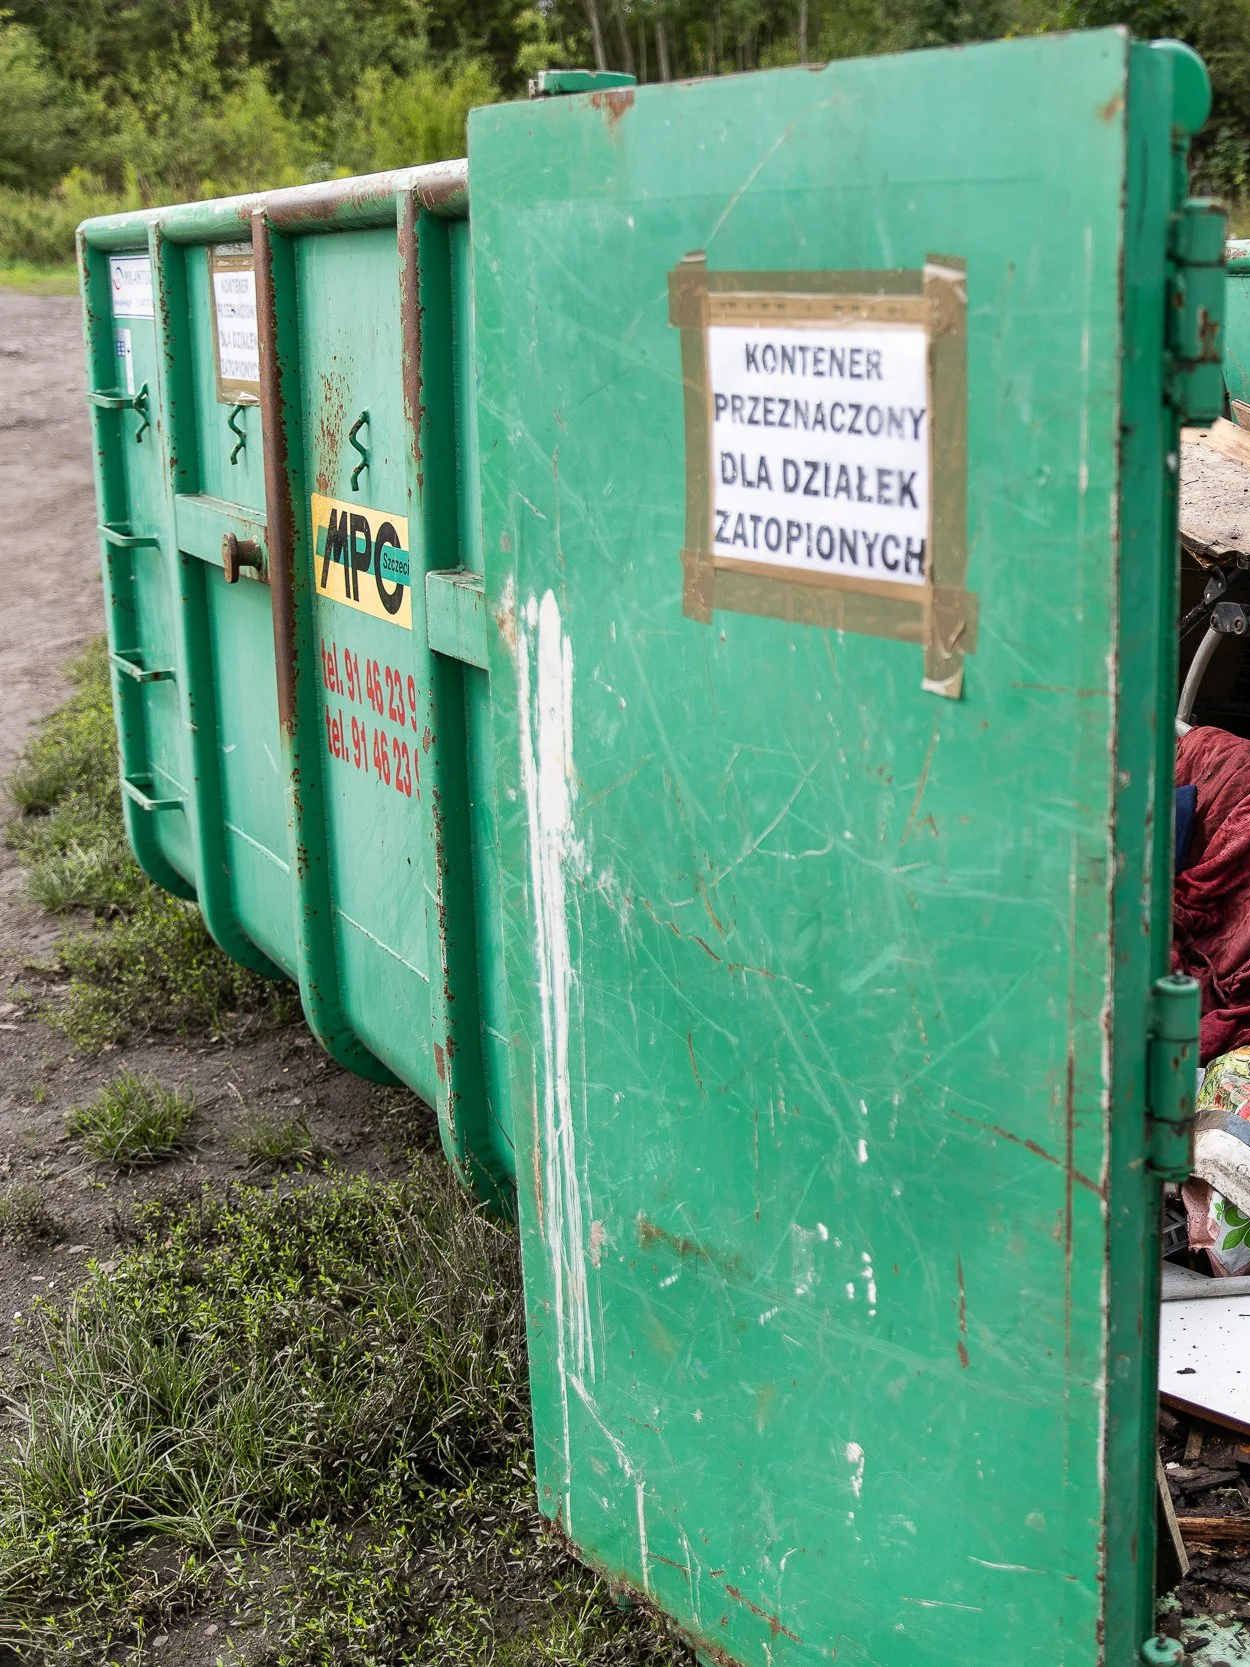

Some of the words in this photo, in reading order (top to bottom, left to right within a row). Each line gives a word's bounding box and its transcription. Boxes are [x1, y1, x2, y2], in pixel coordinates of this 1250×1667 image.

[744, 342, 884, 382] KONTENER
[713, 392, 927, 441] PRZEZNACZONY
[720, 451, 773, 492] DLA
[782, 459, 918, 510] DZIAŁEK
[382, 552, 410, 576] Szczeci
[714, 509, 926, 576] ZATOPIONYCH
[321, 638, 344, 696] tel.
[344, 647, 363, 705] 91
[366, 658, 384, 716] 46
[385, 665, 405, 727] 23
[325, 704, 350, 763] tel.
[351, 715, 368, 773] 91
[373, 728, 391, 786] 46
[392, 736, 412, 798] 23
